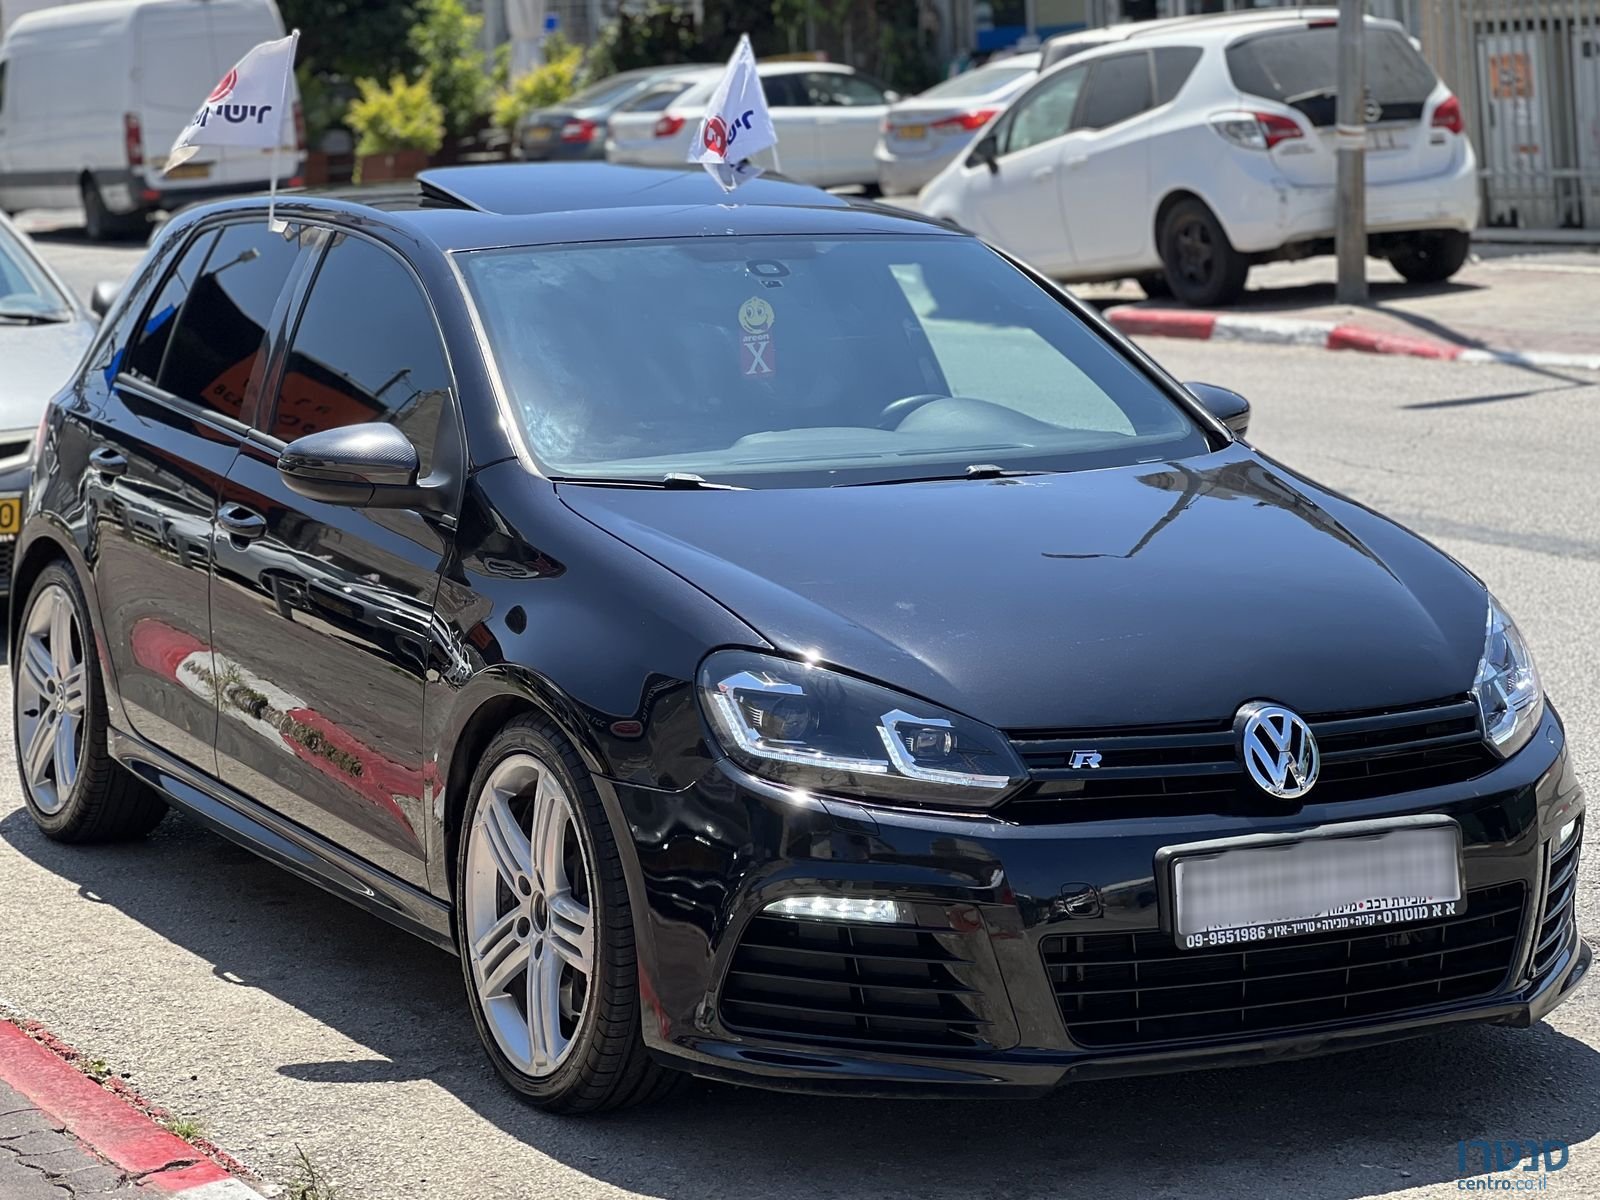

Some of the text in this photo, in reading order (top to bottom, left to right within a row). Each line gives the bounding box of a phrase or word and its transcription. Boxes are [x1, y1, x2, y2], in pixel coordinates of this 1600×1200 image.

[744, 340, 773, 374] X
[1069, 750, 1102, 769] R
[1366, 898, 1388, 911] רכב
[1432, 904, 1442, 917] א
[1445, 902, 1456, 915] א
[1382, 906, 1428, 924] מוטורס
[1322, 917, 1349, 931] מכירה
[1186, 926, 1266, 948] 09-9551986
